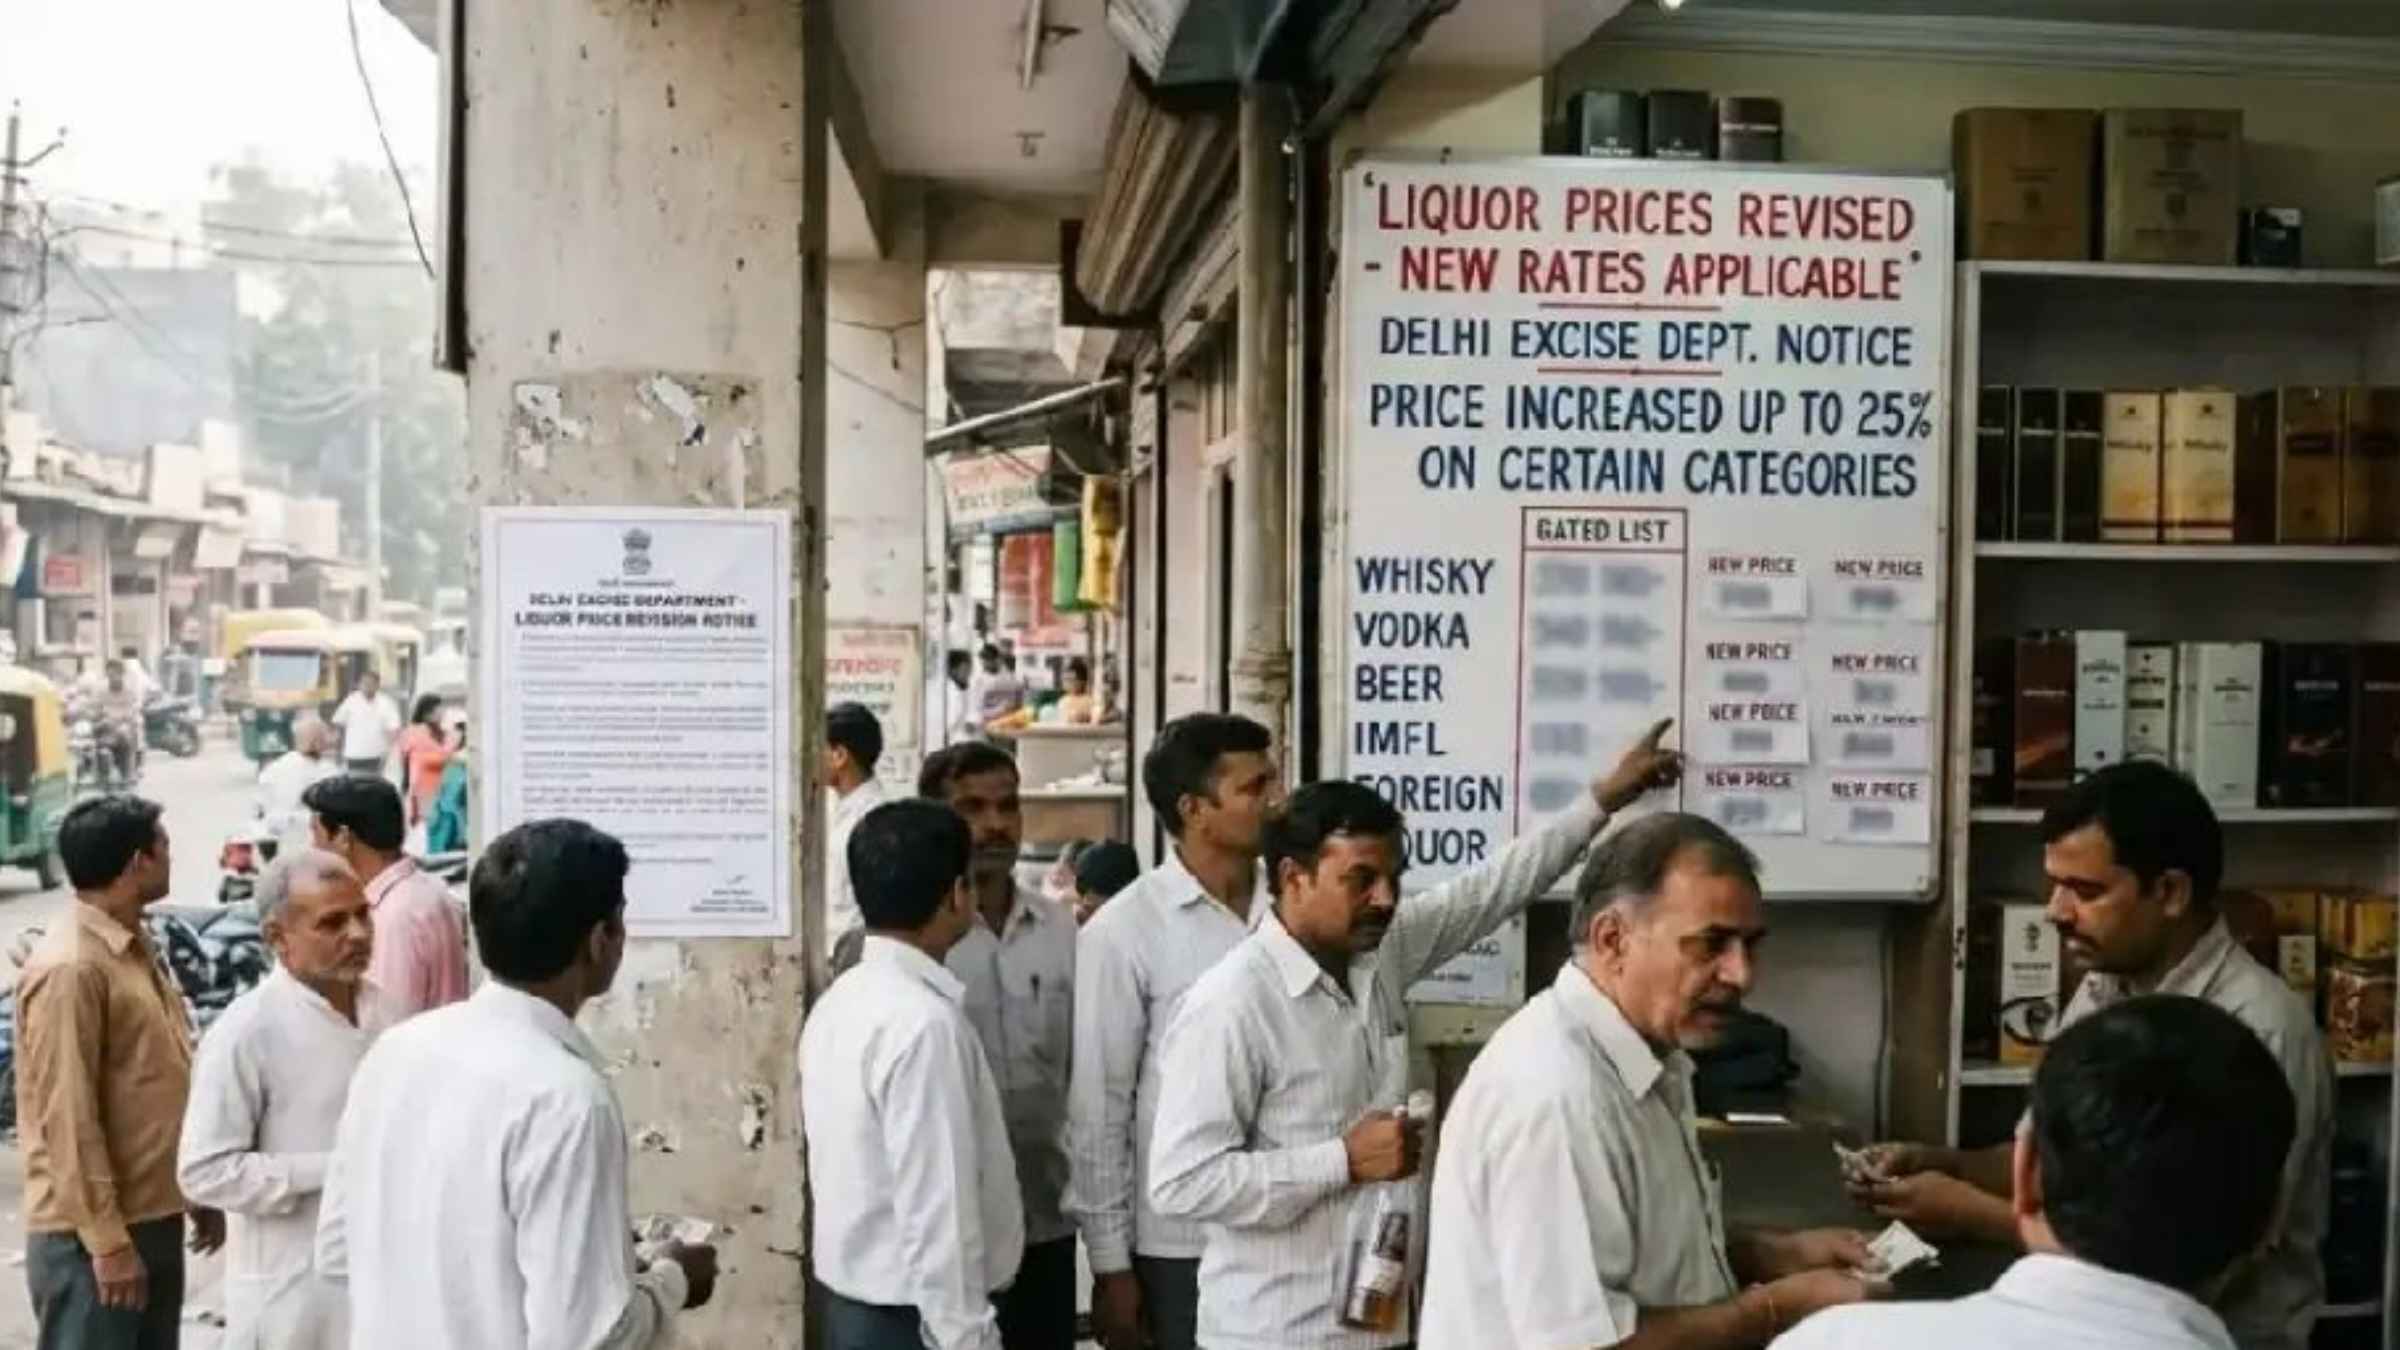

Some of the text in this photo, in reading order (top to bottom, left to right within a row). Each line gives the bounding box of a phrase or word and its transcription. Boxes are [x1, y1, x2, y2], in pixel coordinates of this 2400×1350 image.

[1565, 187, 1713, 237] PRICES
[1739, 192, 1915, 243] REVISED
[1400, 245, 1500, 293] NEW
[1518, 247, 1646, 294] RATES
[1380, 316, 1913, 367] DELHI EXCISE DEPT. NOTICE
[1370, 383, 1933, 439] PRICE INCREASED UP TO 25%
[1418, 445, 1917, 499] ON CERTAIN CATEGORIES
[1618, 518, 1670, 543] LIST
[1354, 556, 1495, 595] WHISKY
[1353, 611, 1470, 650] VODKA
[1355, 663, 1443, 703] BEER
[1354, 721, 1448, 757] IMFL
[1354, 774, 1503, 813] OREIGN
